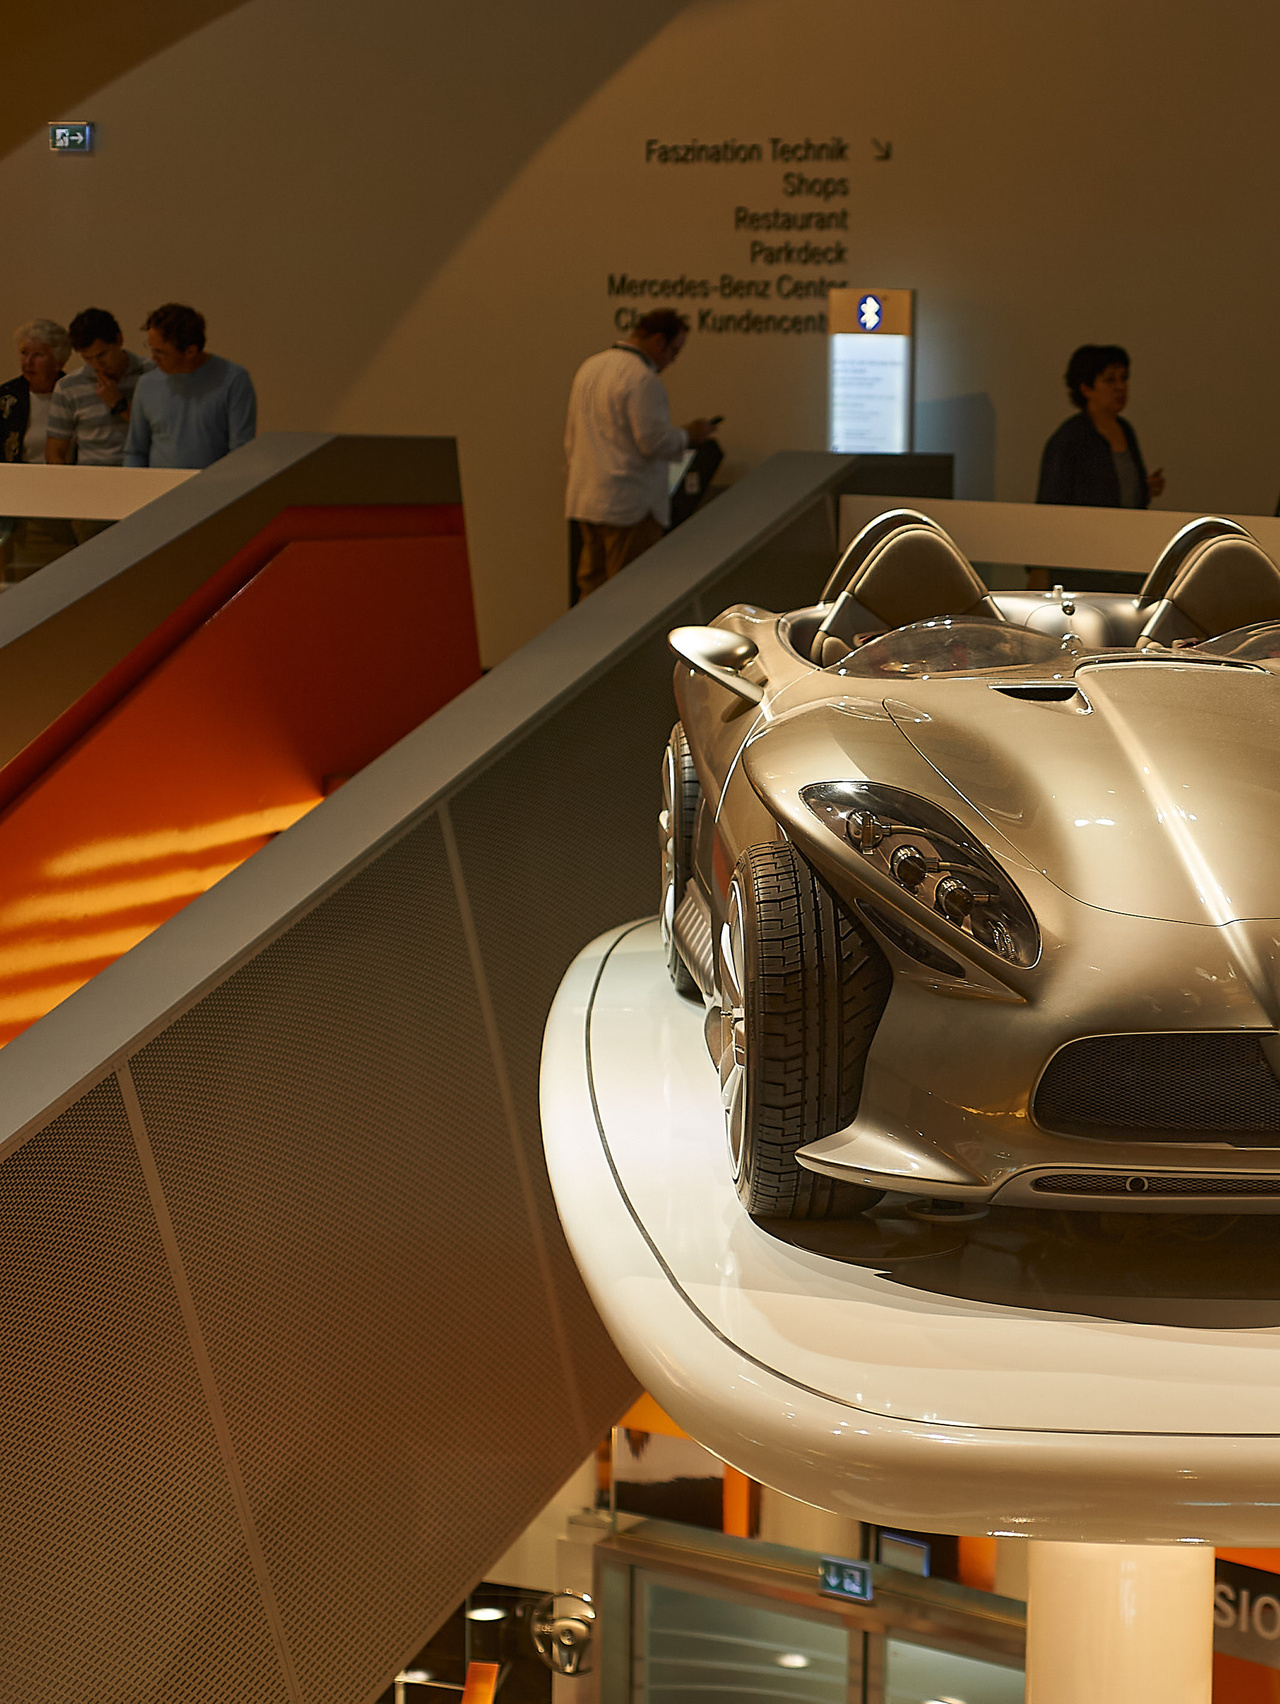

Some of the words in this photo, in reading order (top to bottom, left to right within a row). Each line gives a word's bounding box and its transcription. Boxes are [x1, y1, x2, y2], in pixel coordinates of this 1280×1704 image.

[645, 139, 763, 164] Faszination
[769, 138, 849, 163] Technik
[783, 172, 849, 200] Shops
[735, 206, 848, 231] Restaurant
[750, 240, 847, 265] Parkdeck
[608, 273, 770, 299] Mercedes-Benz
[698, 308, 827, 334] Kundencent
